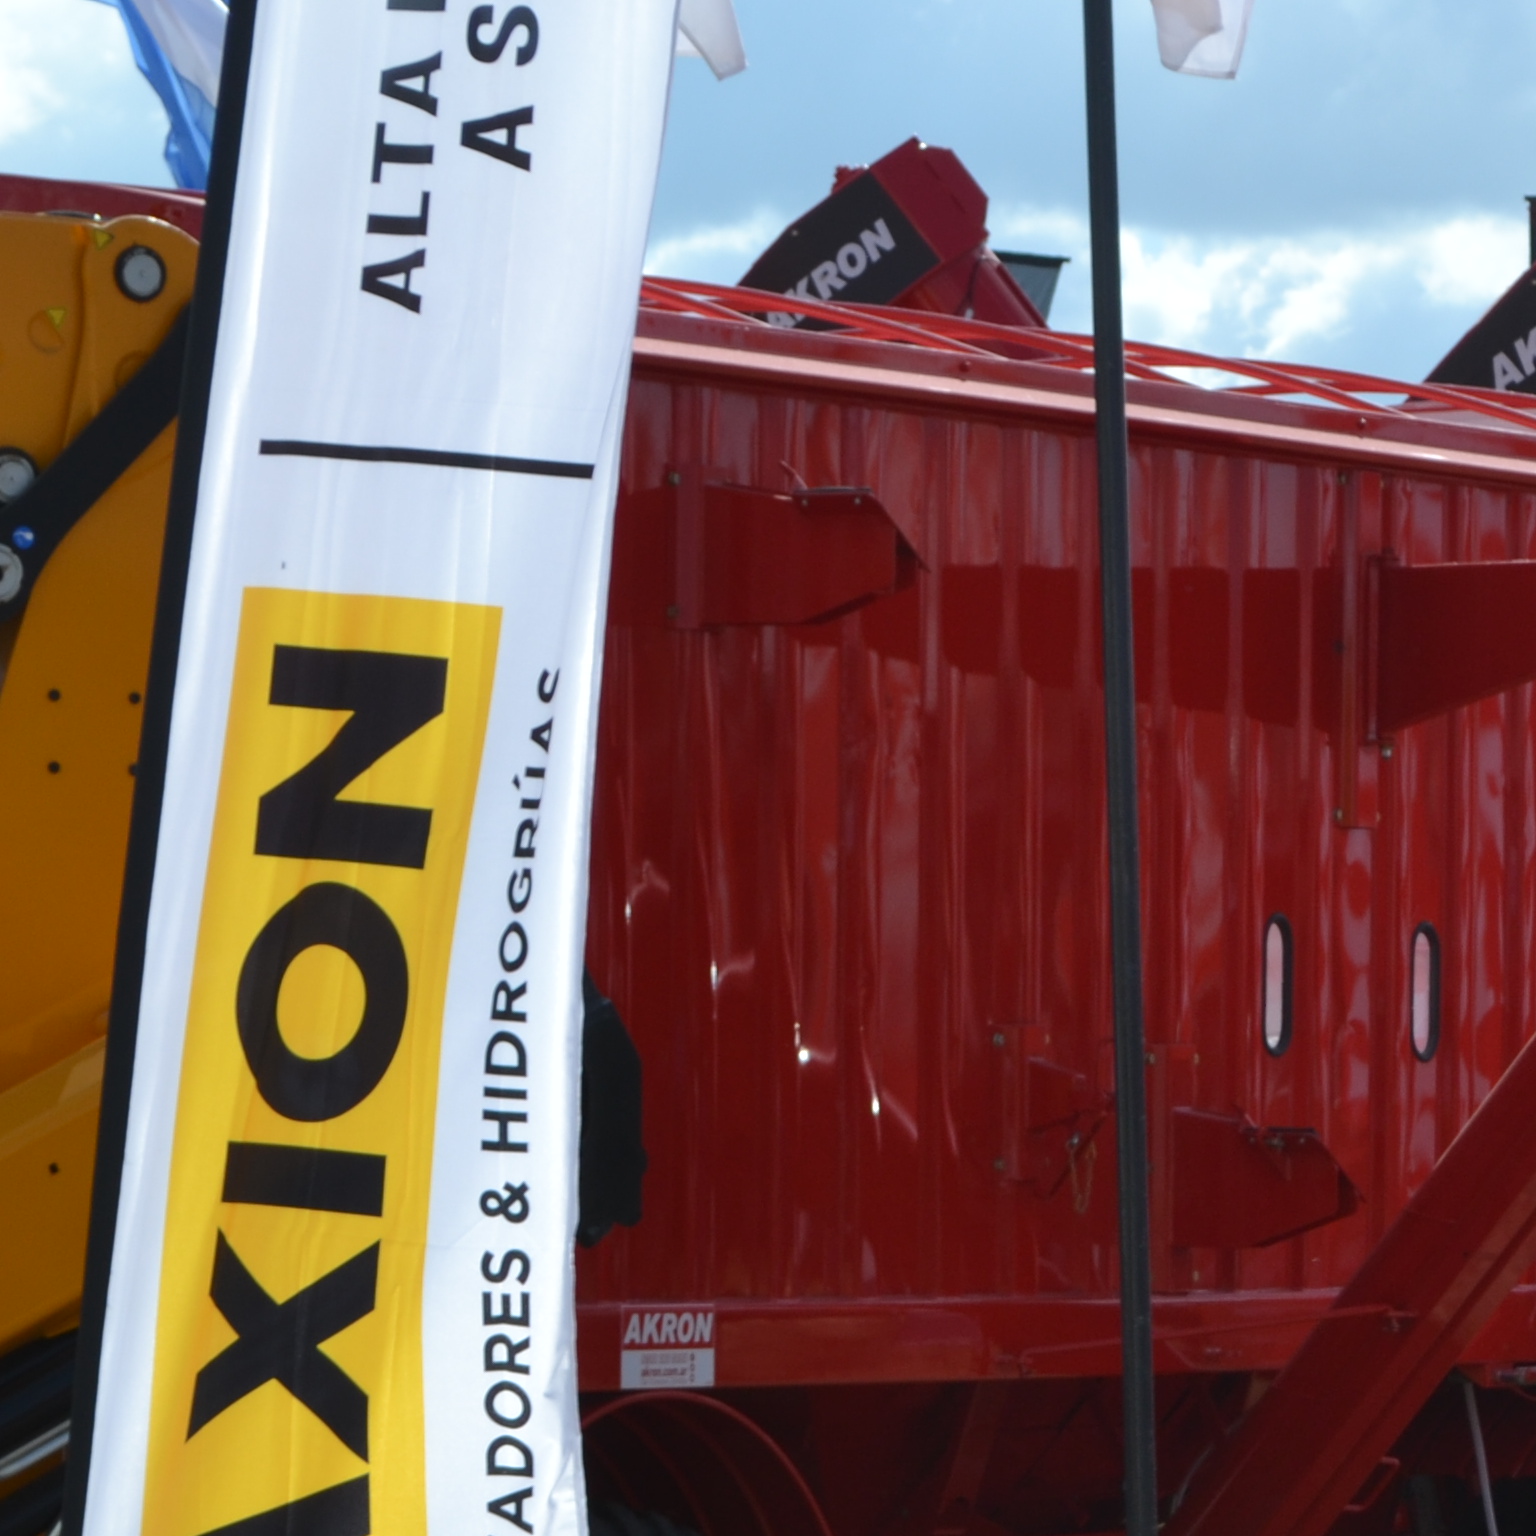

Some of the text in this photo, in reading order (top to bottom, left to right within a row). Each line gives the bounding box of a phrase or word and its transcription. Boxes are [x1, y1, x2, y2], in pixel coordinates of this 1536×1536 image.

[361, 50, 443, 315] ALTA
[479, 1182, 531, 1223] &
[624, 1311, 714, 1345] AKRON
